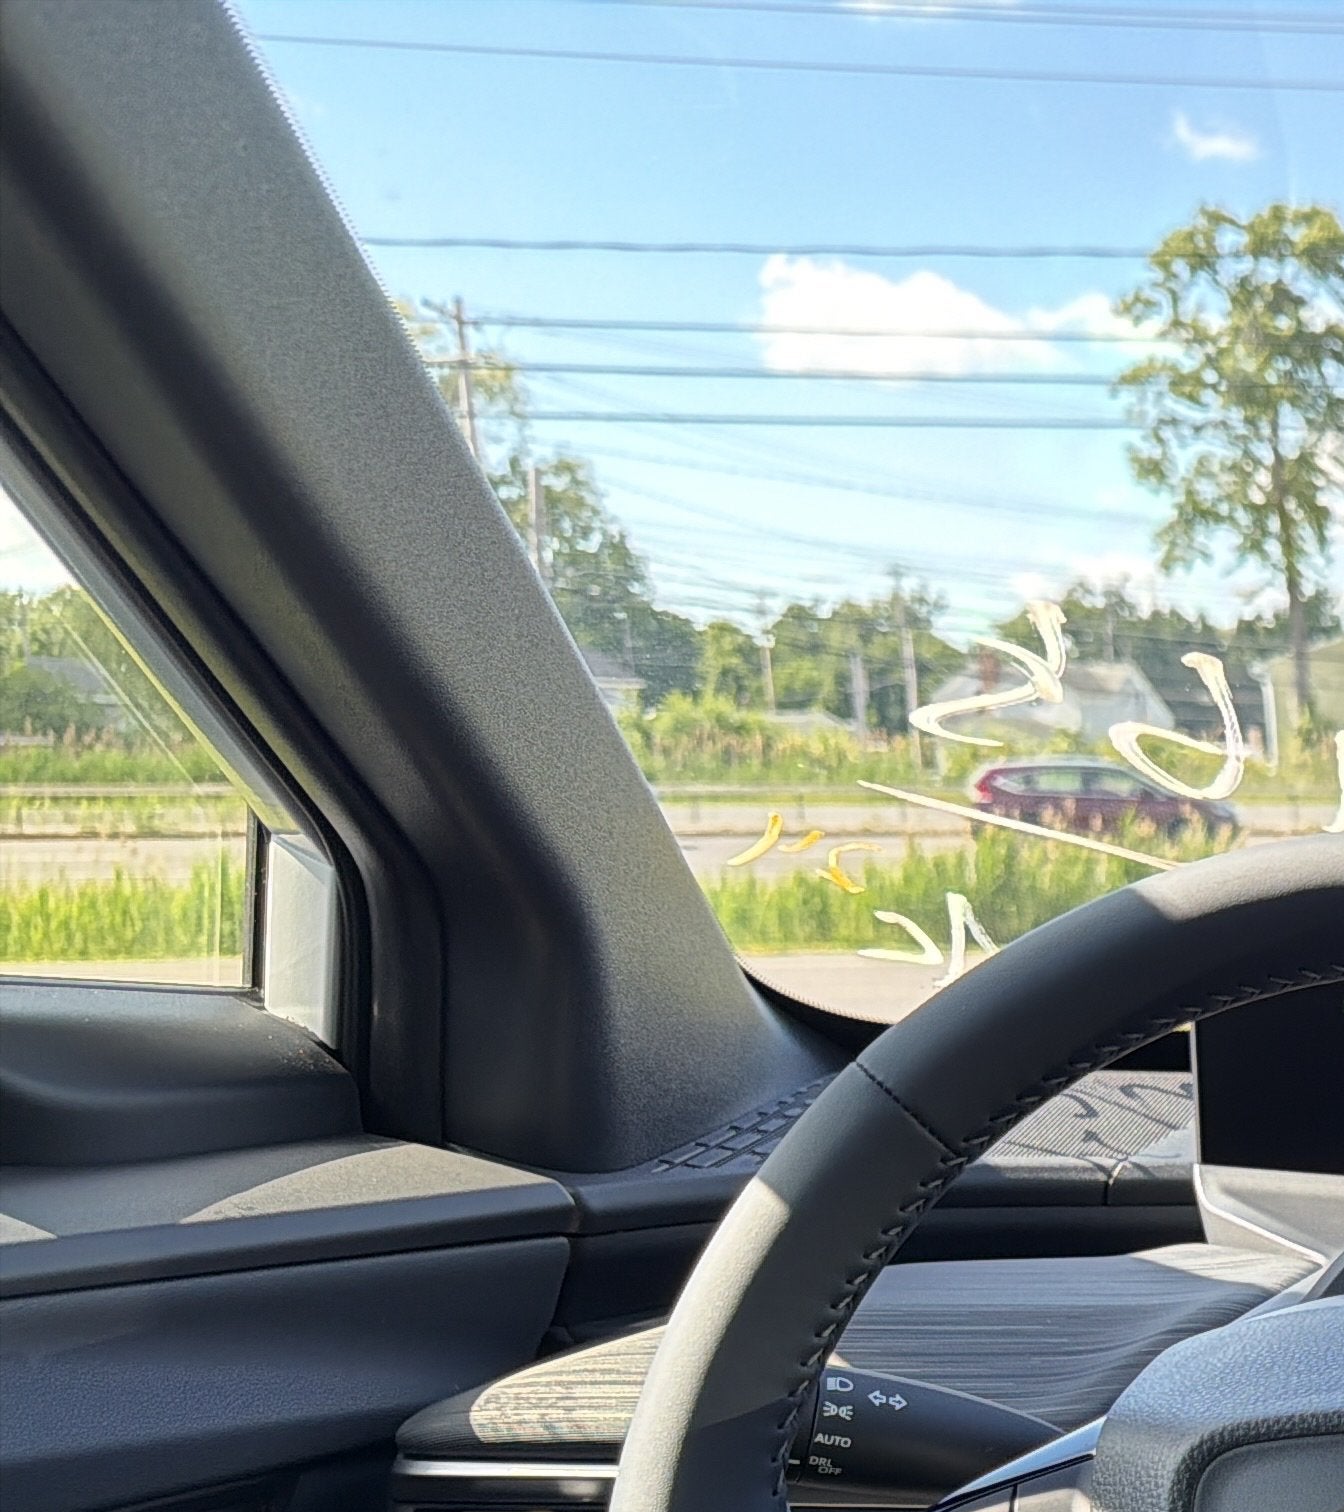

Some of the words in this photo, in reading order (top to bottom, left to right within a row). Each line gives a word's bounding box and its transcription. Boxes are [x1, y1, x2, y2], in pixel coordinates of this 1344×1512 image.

[814, 1433, 852, 1448] AUTO
[808, 1455, 833, 1468] DRL
[818, 1466, 842, 1475] OFF
